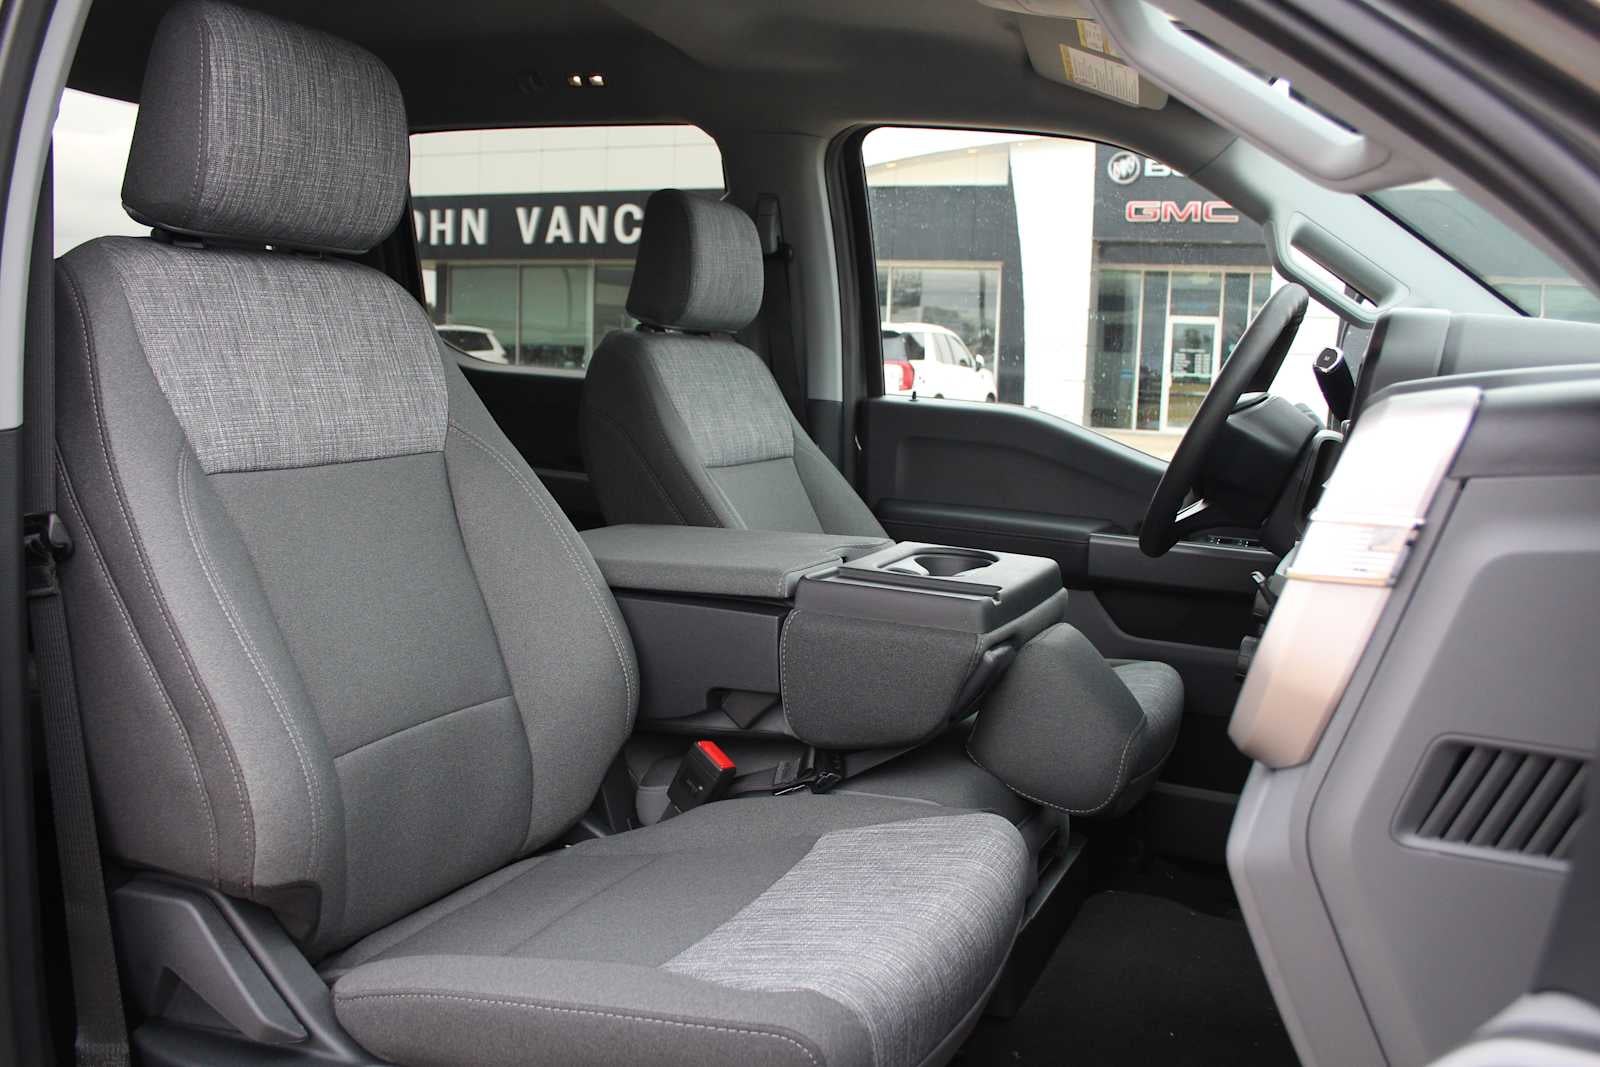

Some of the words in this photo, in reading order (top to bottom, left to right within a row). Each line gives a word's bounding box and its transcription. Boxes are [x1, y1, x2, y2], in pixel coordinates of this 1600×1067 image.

[1144, 158, 1184, 177] B
[1125, 200, 1239, 223] GMC
[516, 203, 643, 244] VANC
